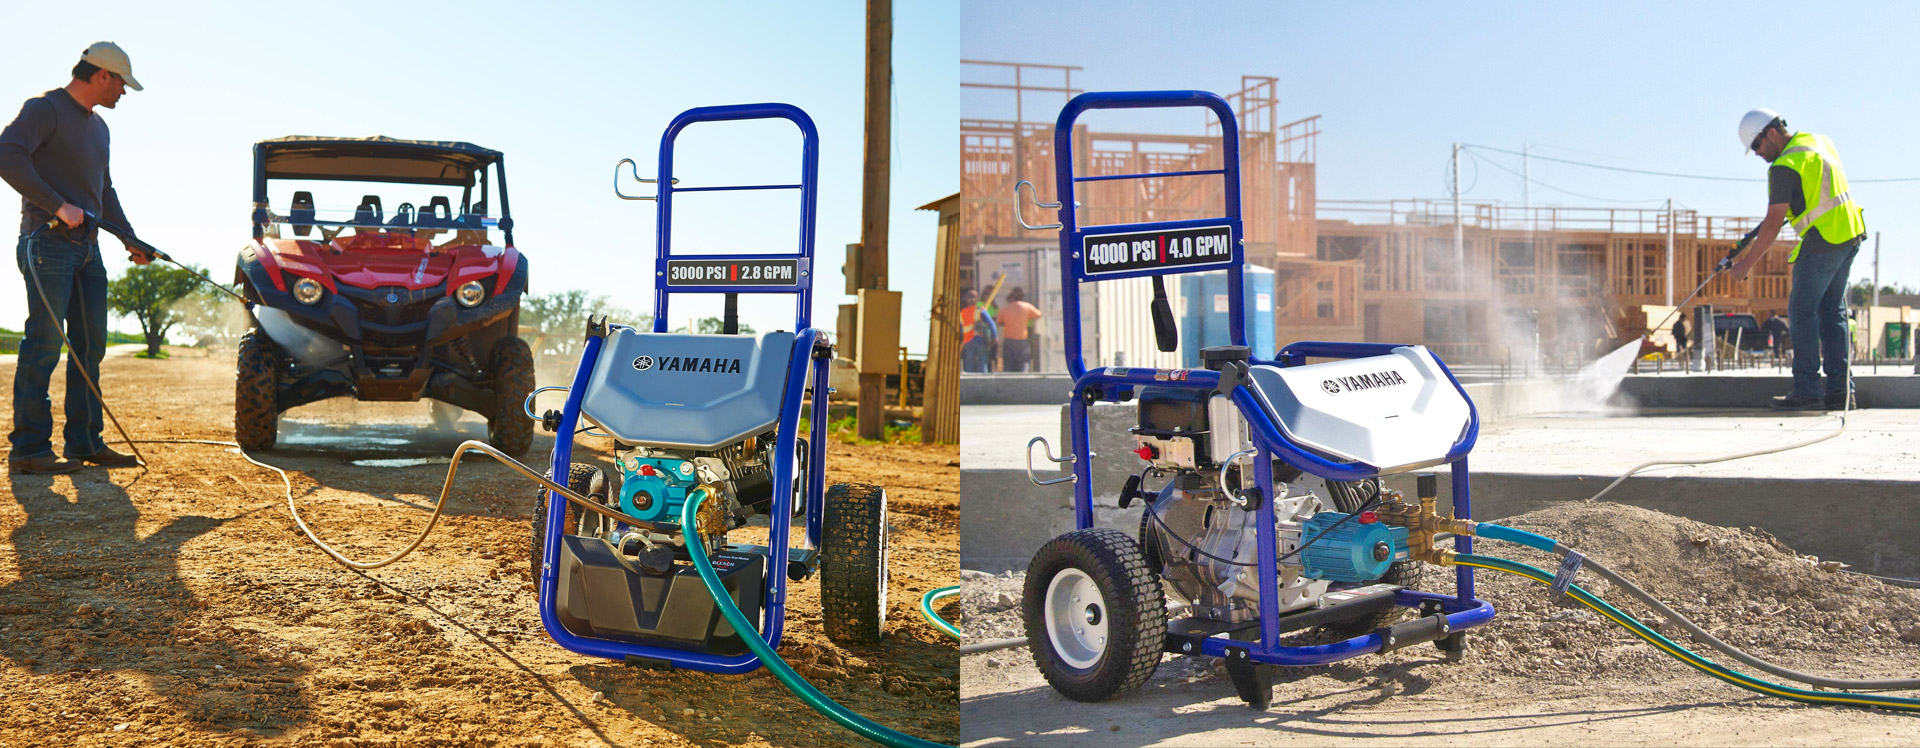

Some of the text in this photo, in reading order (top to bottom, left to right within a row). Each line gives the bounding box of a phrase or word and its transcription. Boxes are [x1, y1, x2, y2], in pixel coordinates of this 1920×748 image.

[1089, 234, 1228, 265] 4000 PSI 4.0 GPM
[671, 265, 792, 280] 3000 PSI 2.8 GPM
[658, 356, 741, 374] YAMAHA
[1336, 370, 1407, 392] YAMAHA
